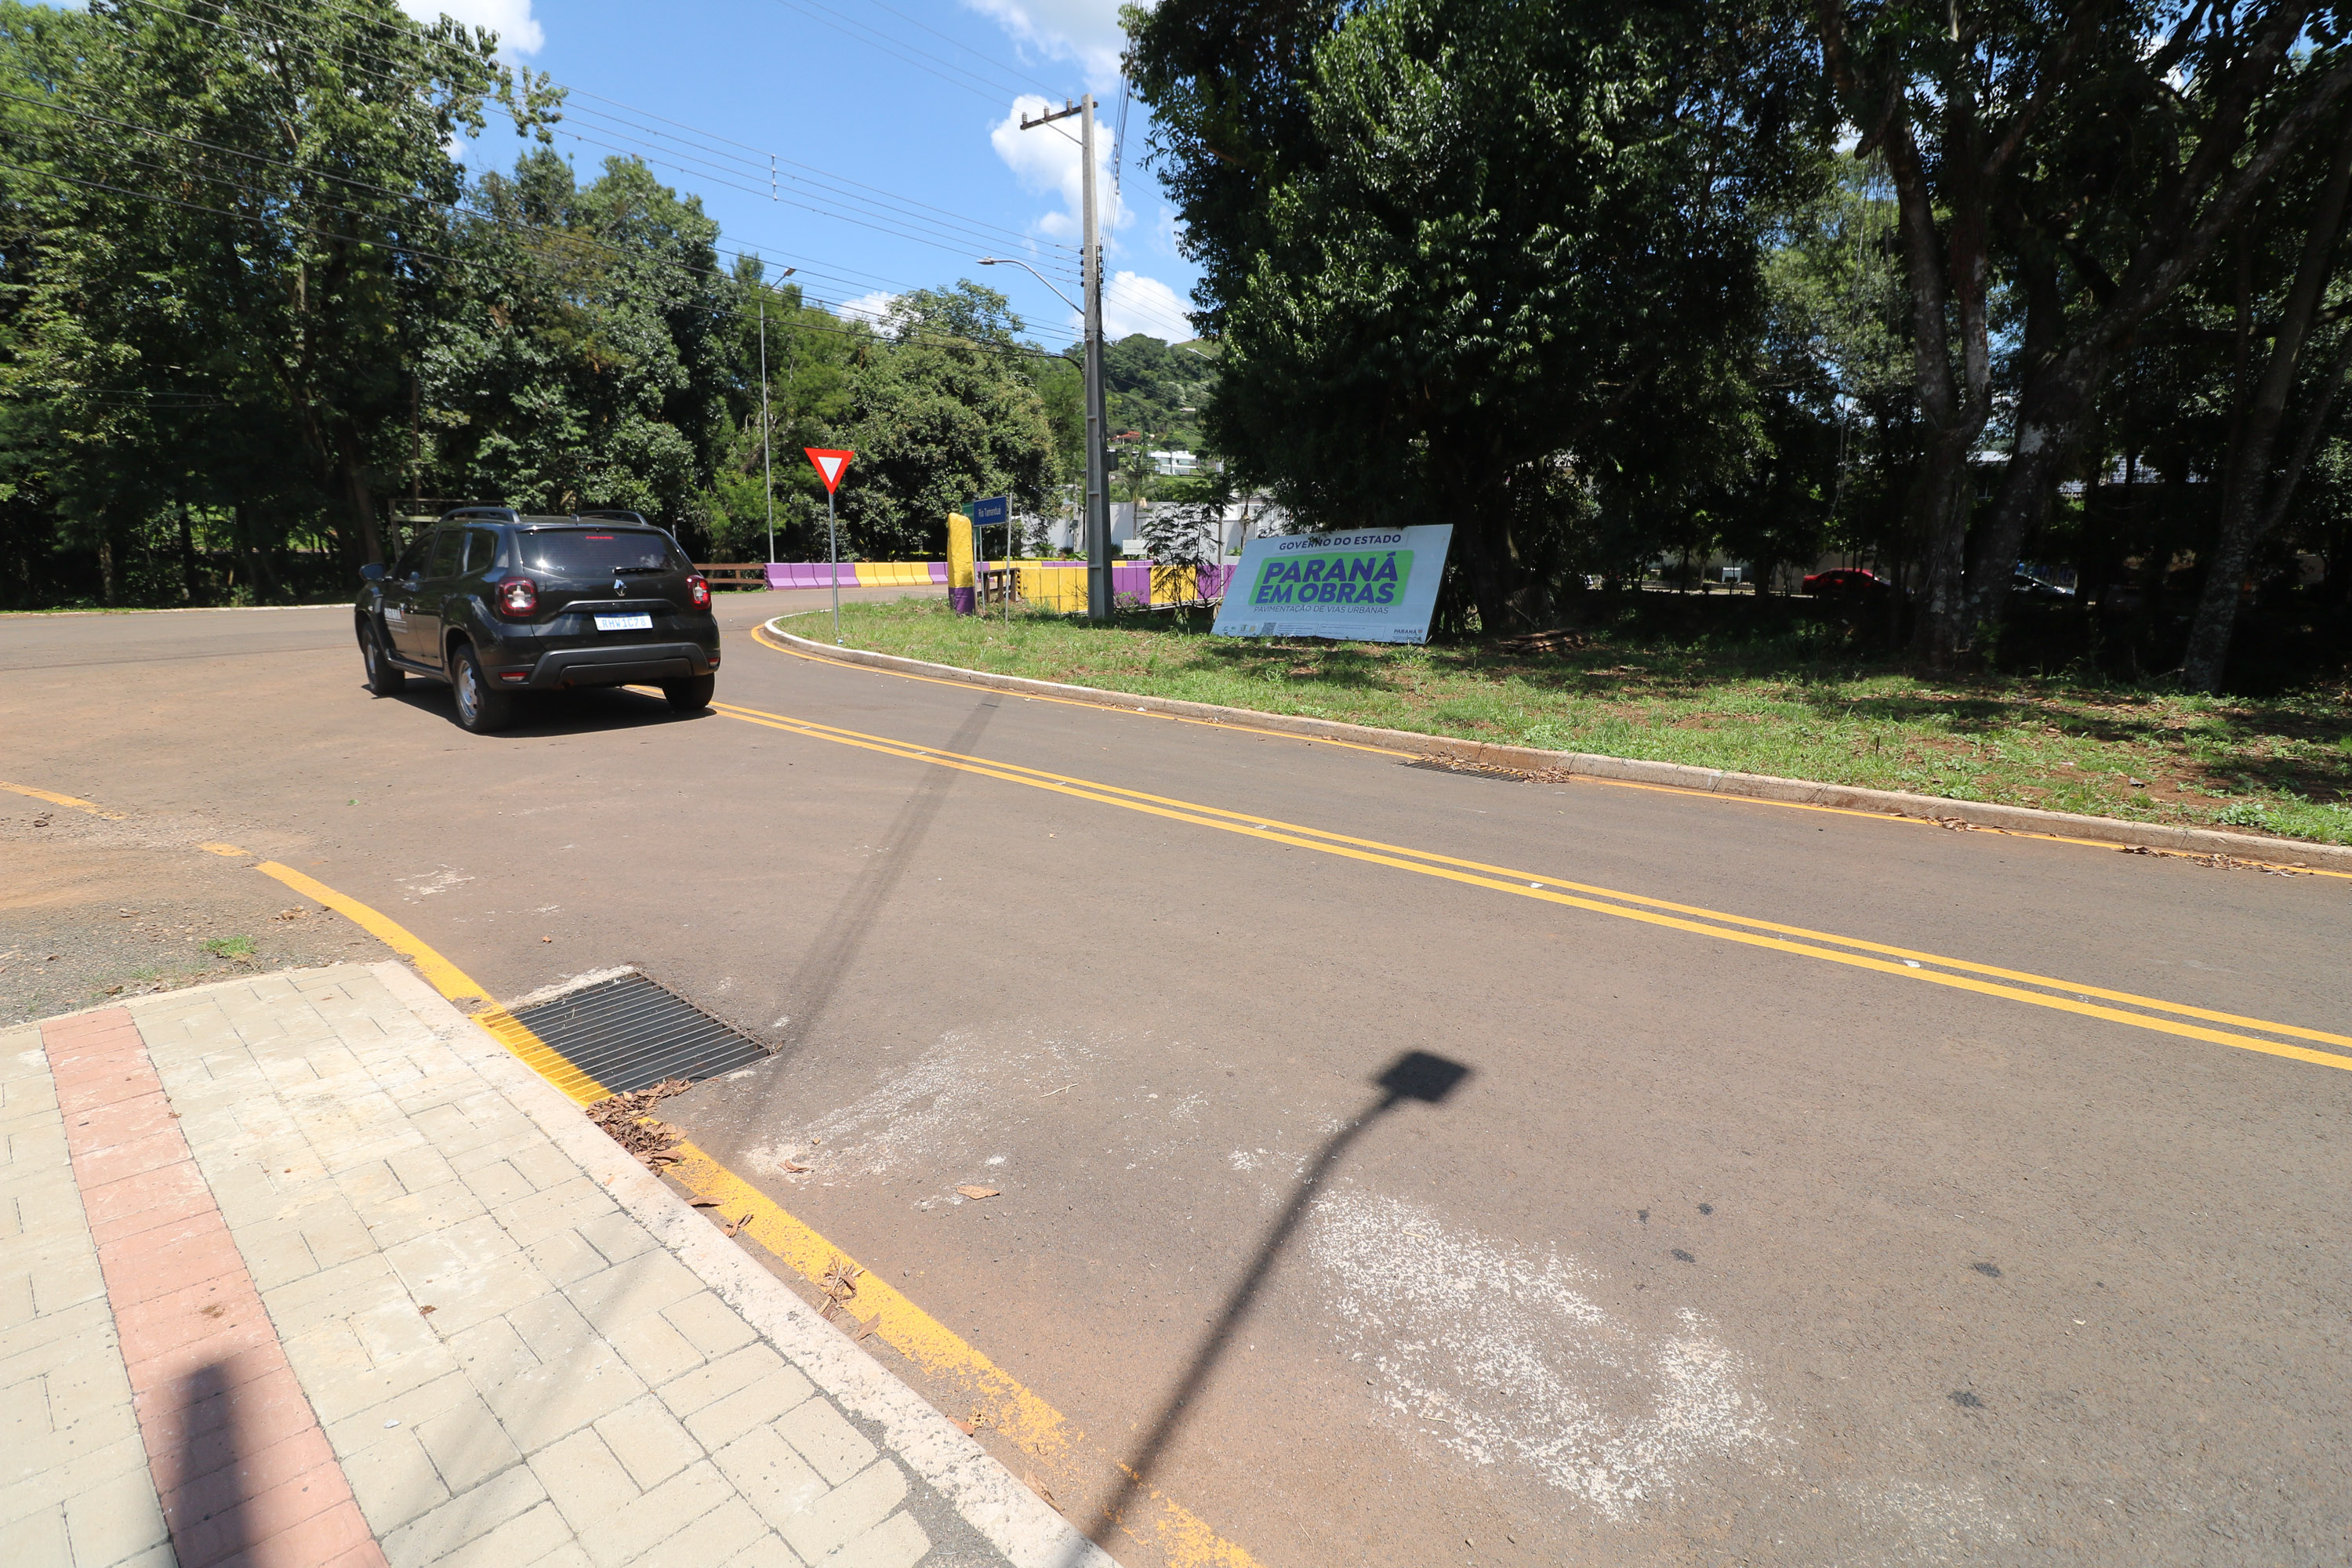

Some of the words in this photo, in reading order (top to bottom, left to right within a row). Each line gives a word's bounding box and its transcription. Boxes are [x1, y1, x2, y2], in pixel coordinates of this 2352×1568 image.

[1279, 538, 1331, 550] GOVERNO
[1334, 537, 1352, 546] DO
[1354, 535, 1402, 545] ESTADO
[1262, 551, 1398, 584] PARANÁ
[1255, 583, 1294, 604] EM
[1298, 583, 1396, 604] OBRAS
[1254, 604, 1312, 613] PAVIMENTAÇÃO
[601, 618, 646, 628] RHW1C78
